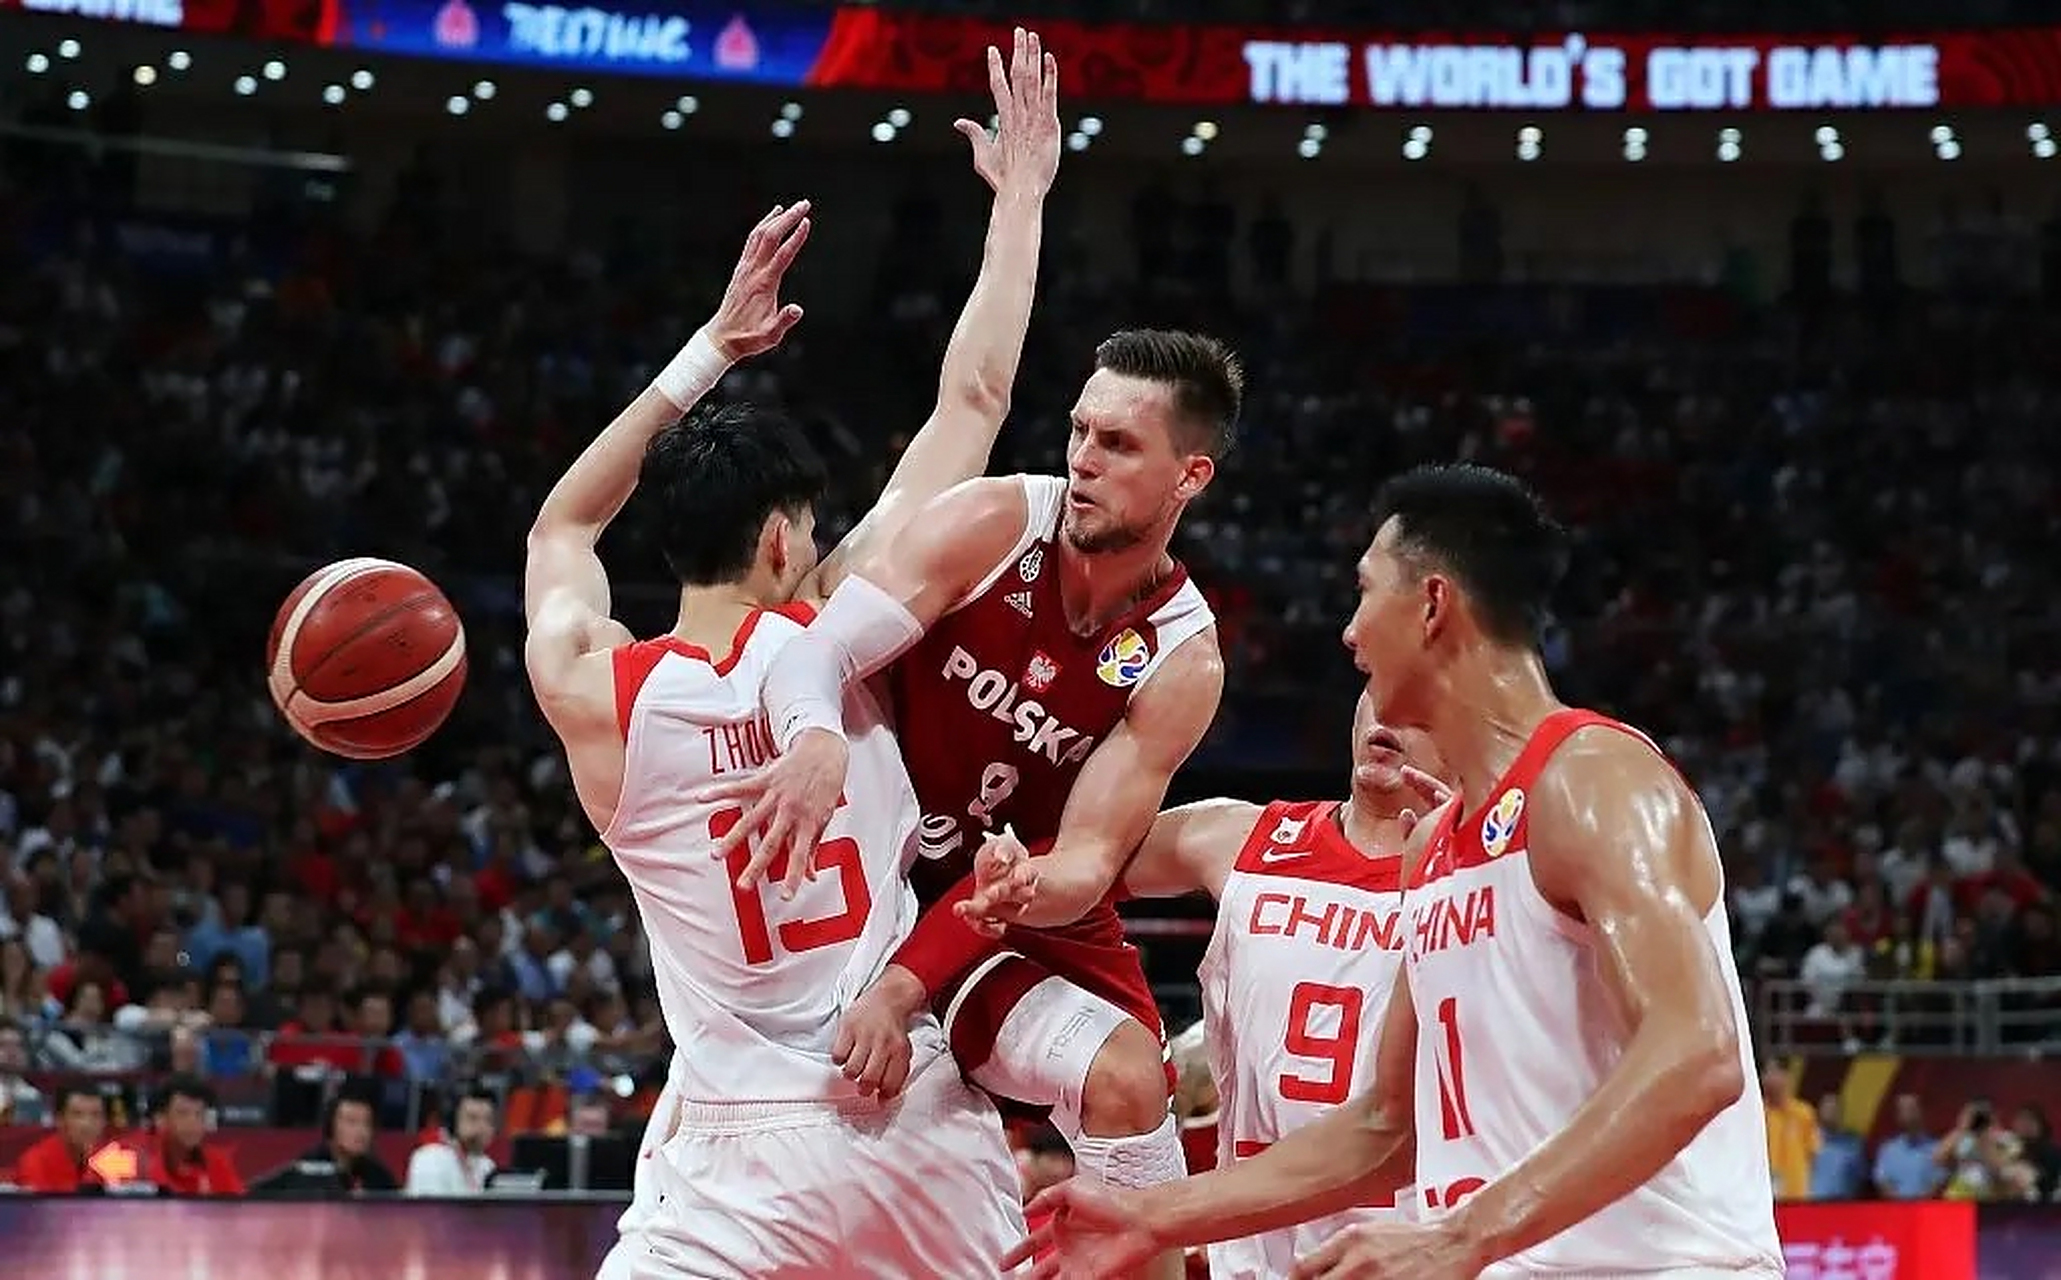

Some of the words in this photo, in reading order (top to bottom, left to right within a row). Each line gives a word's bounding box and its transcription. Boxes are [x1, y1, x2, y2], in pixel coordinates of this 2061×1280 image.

[1243, 41, 1350, 104] THE
[1366, 33, 1626, 107] WORLD'S
[1648, 46, 1760, 108] GOT
[1768, 45, 1939, 107] GAME
[1412, 885, 1494, 963] HINA
[1278, 982, 1363, 1104] 9
